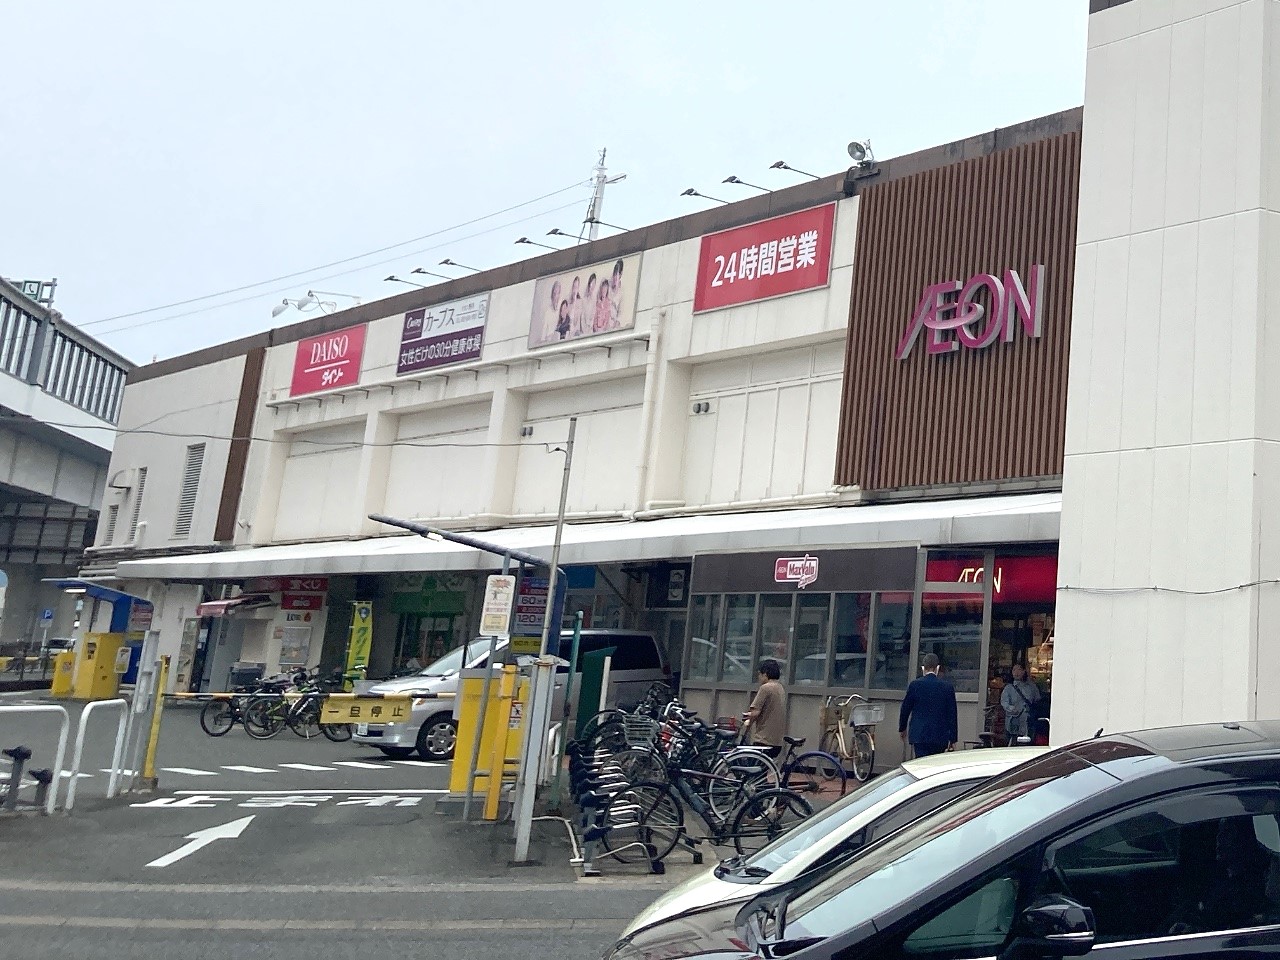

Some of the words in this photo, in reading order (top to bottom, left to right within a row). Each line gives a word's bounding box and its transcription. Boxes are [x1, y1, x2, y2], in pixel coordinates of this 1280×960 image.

[711, 230, 819, 289] 24時間営業
[310, 334, 349, 365] DAISO
[327, 705, 404, 718] 一旦停止
[128, 795, 423, 808] 止まれ
